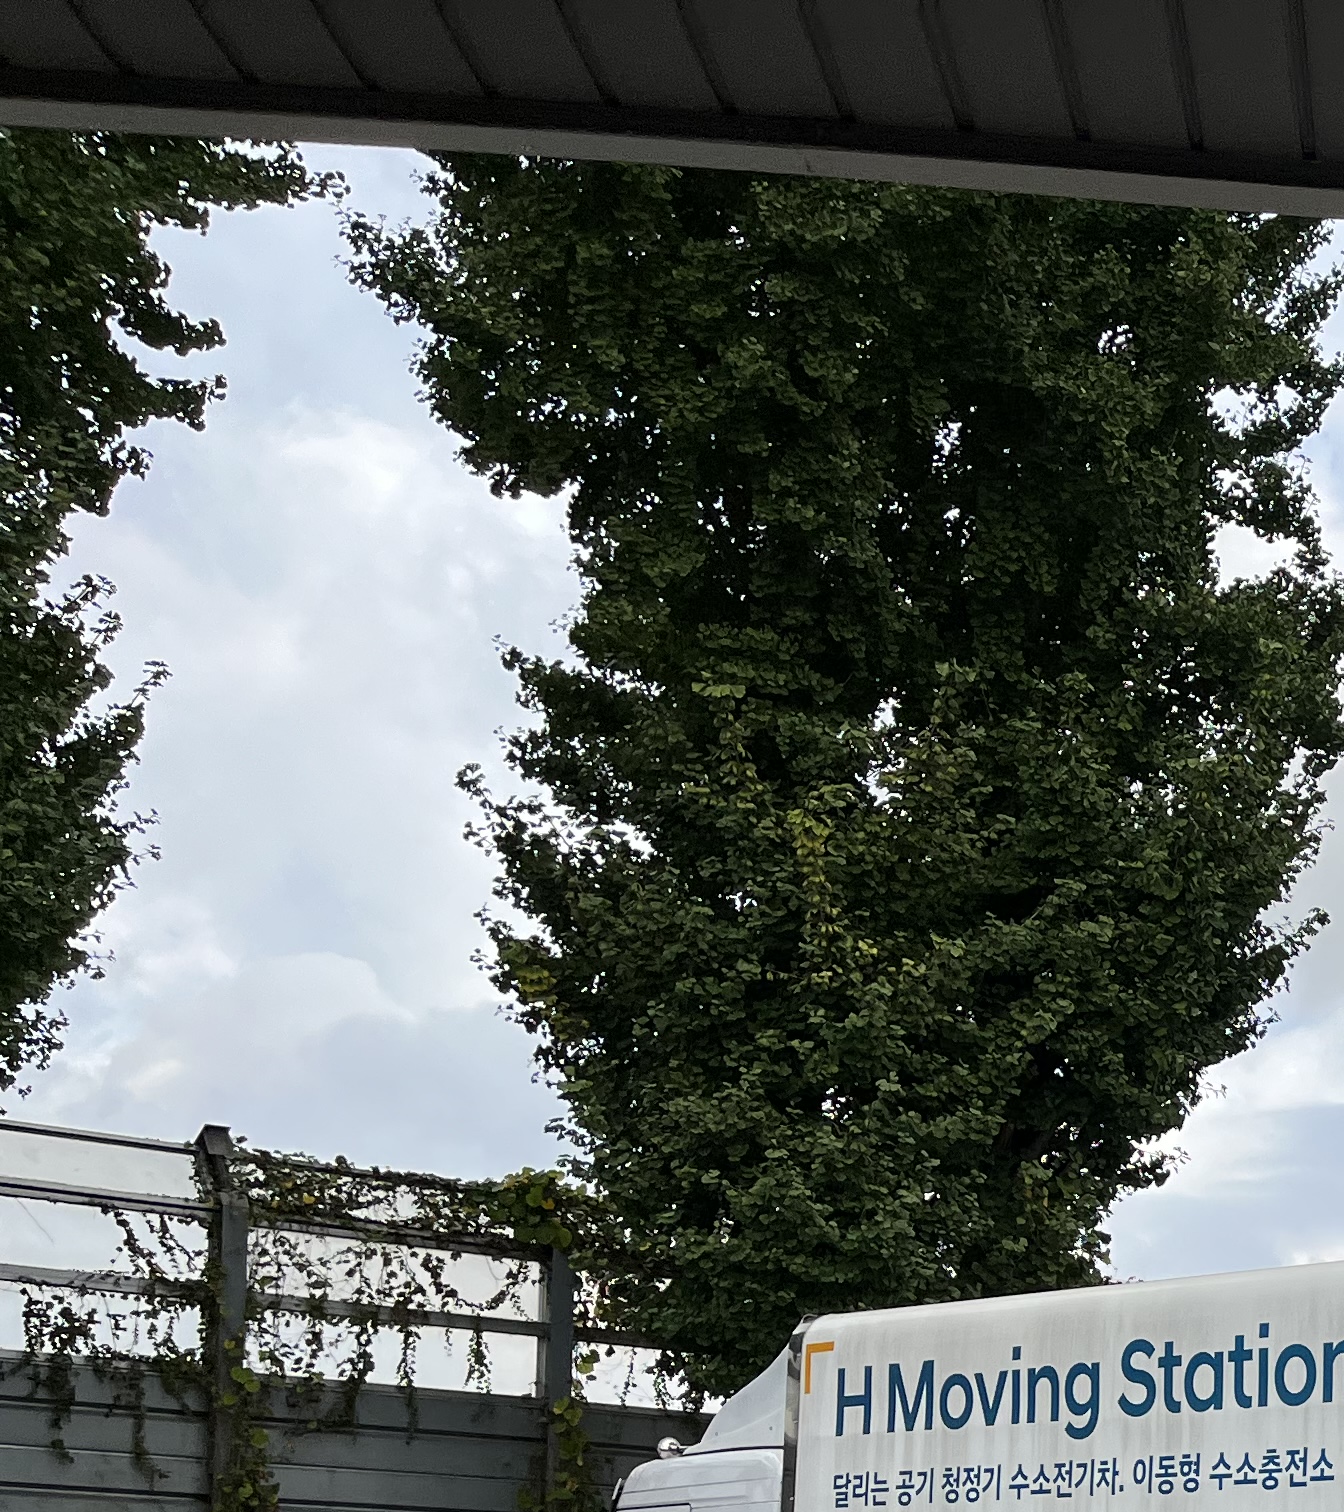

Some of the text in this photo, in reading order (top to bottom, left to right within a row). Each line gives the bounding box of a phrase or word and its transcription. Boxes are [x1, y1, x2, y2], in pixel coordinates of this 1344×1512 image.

[835, 1365, 873, 1438] H
[886, 1345, 1101, 1440] Moving
[832, 1471, 890, 1509] 달리는
[895, 1467, 935, 1507] 공기
[940, 1463, 1003, 1505] 청정기
[1132, 1452, 1201, 1495] 이동형
[1208, 1446, 1335, 1491] 수소충전소
